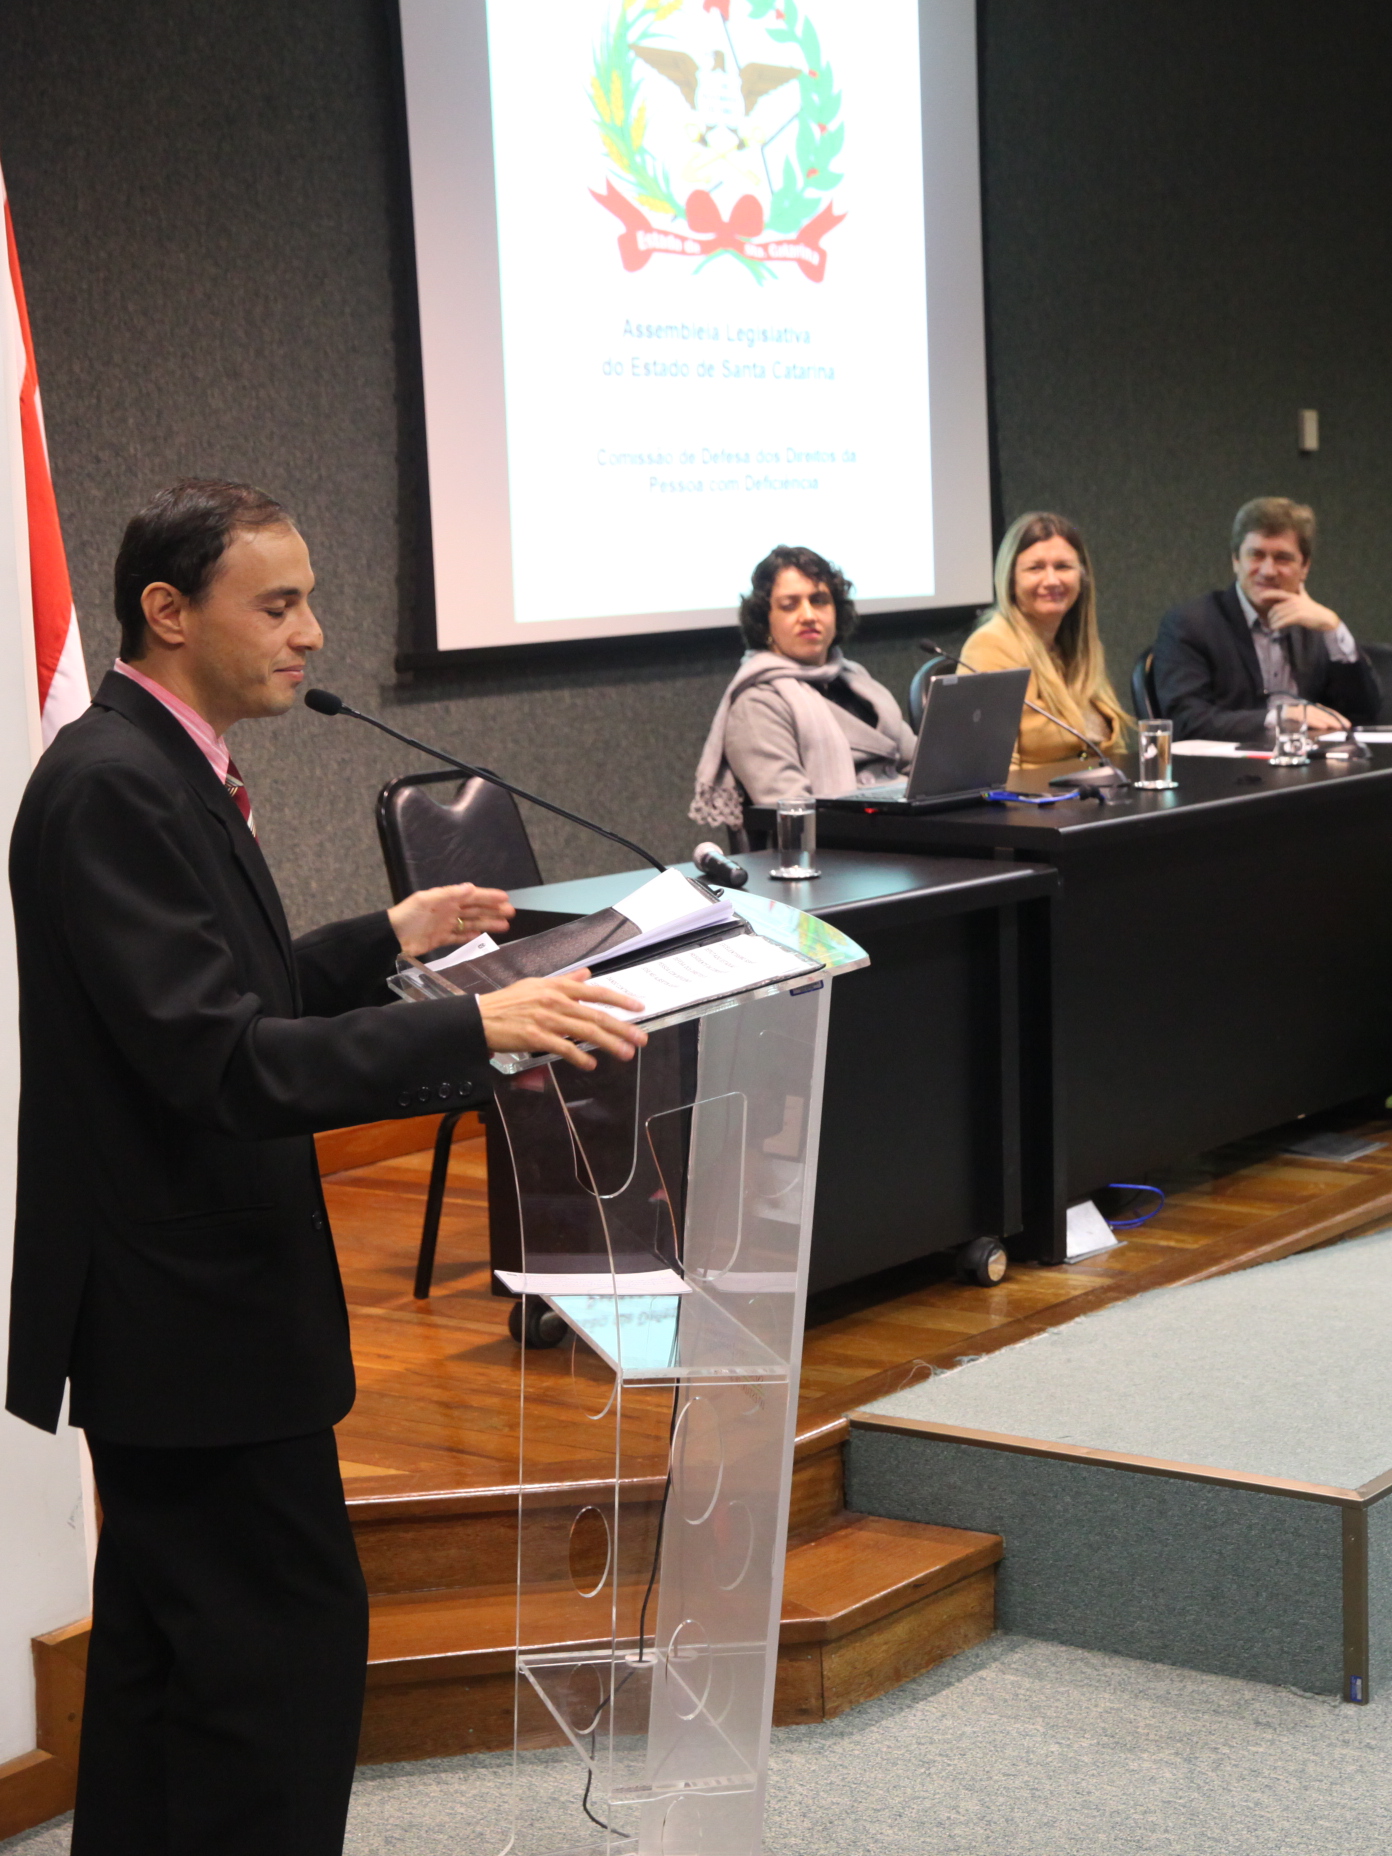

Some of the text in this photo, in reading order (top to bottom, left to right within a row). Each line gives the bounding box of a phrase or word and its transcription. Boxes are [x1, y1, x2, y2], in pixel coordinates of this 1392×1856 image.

[623, 318, 811, 348] Assembleia Legislativa
[602, 356, 835, 381] do Estado de Santa Catarina
[597, 447, 857, 466] Comissão de Defesa dos Direitos da
[649, 476, 704, 493] Pessoa
[709, 478, 740, 492] com
